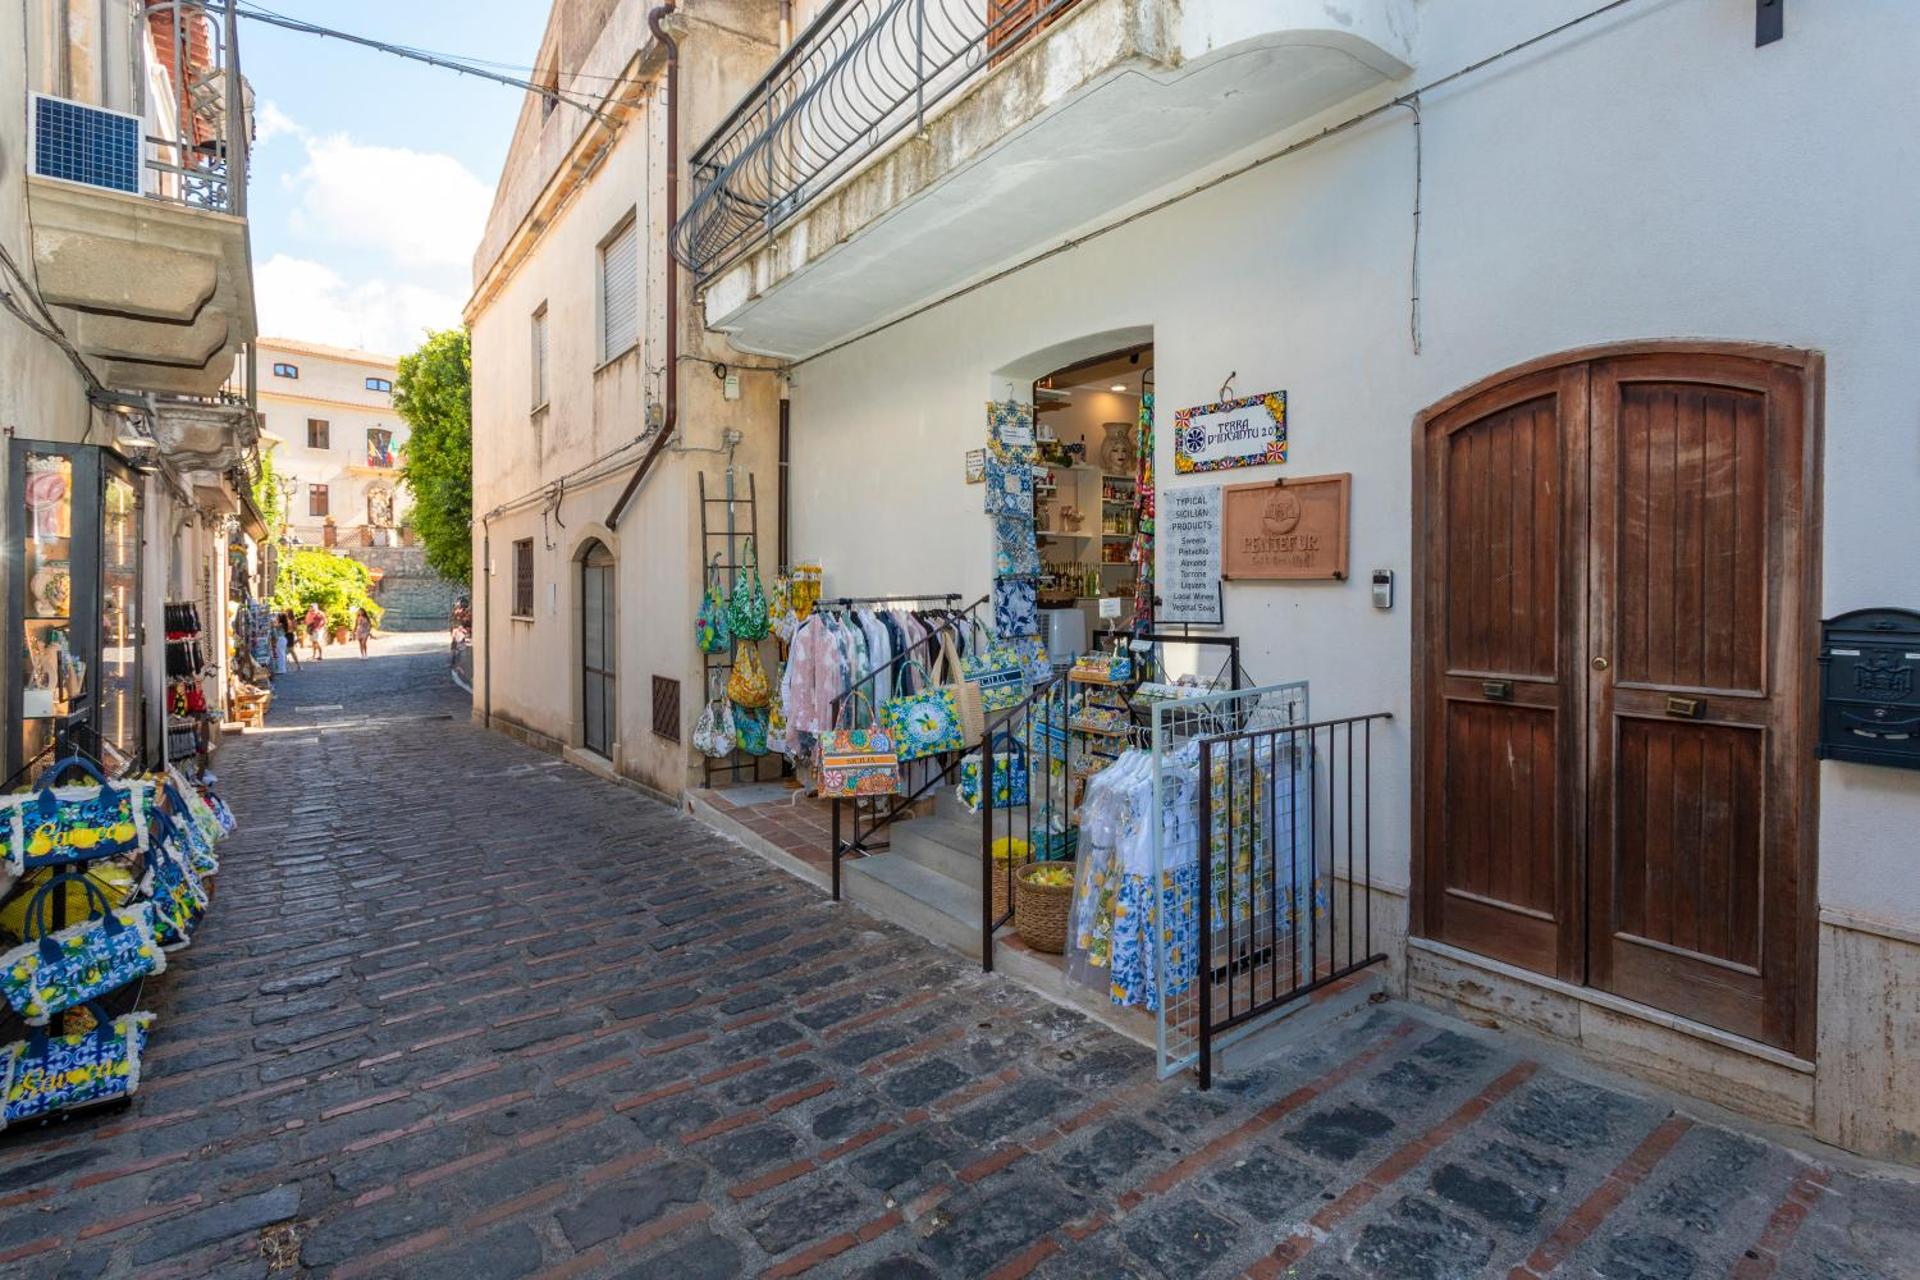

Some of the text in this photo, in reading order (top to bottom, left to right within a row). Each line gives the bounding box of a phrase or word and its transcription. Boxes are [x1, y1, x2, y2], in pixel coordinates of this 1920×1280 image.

[1218, 419, 1249, 433] TERRA
[1208, 427, 1259, 445] D'INCANTU
[1175, 496, 1207, 506] TYPICAL
[1175, 508, 1209, 519] SICILIAN
[1171, 520, 1212, 531] PRODUCTS
[1180, 559, 1207, 568] Almond
[1181, 570, 1207, 578] Torrone
